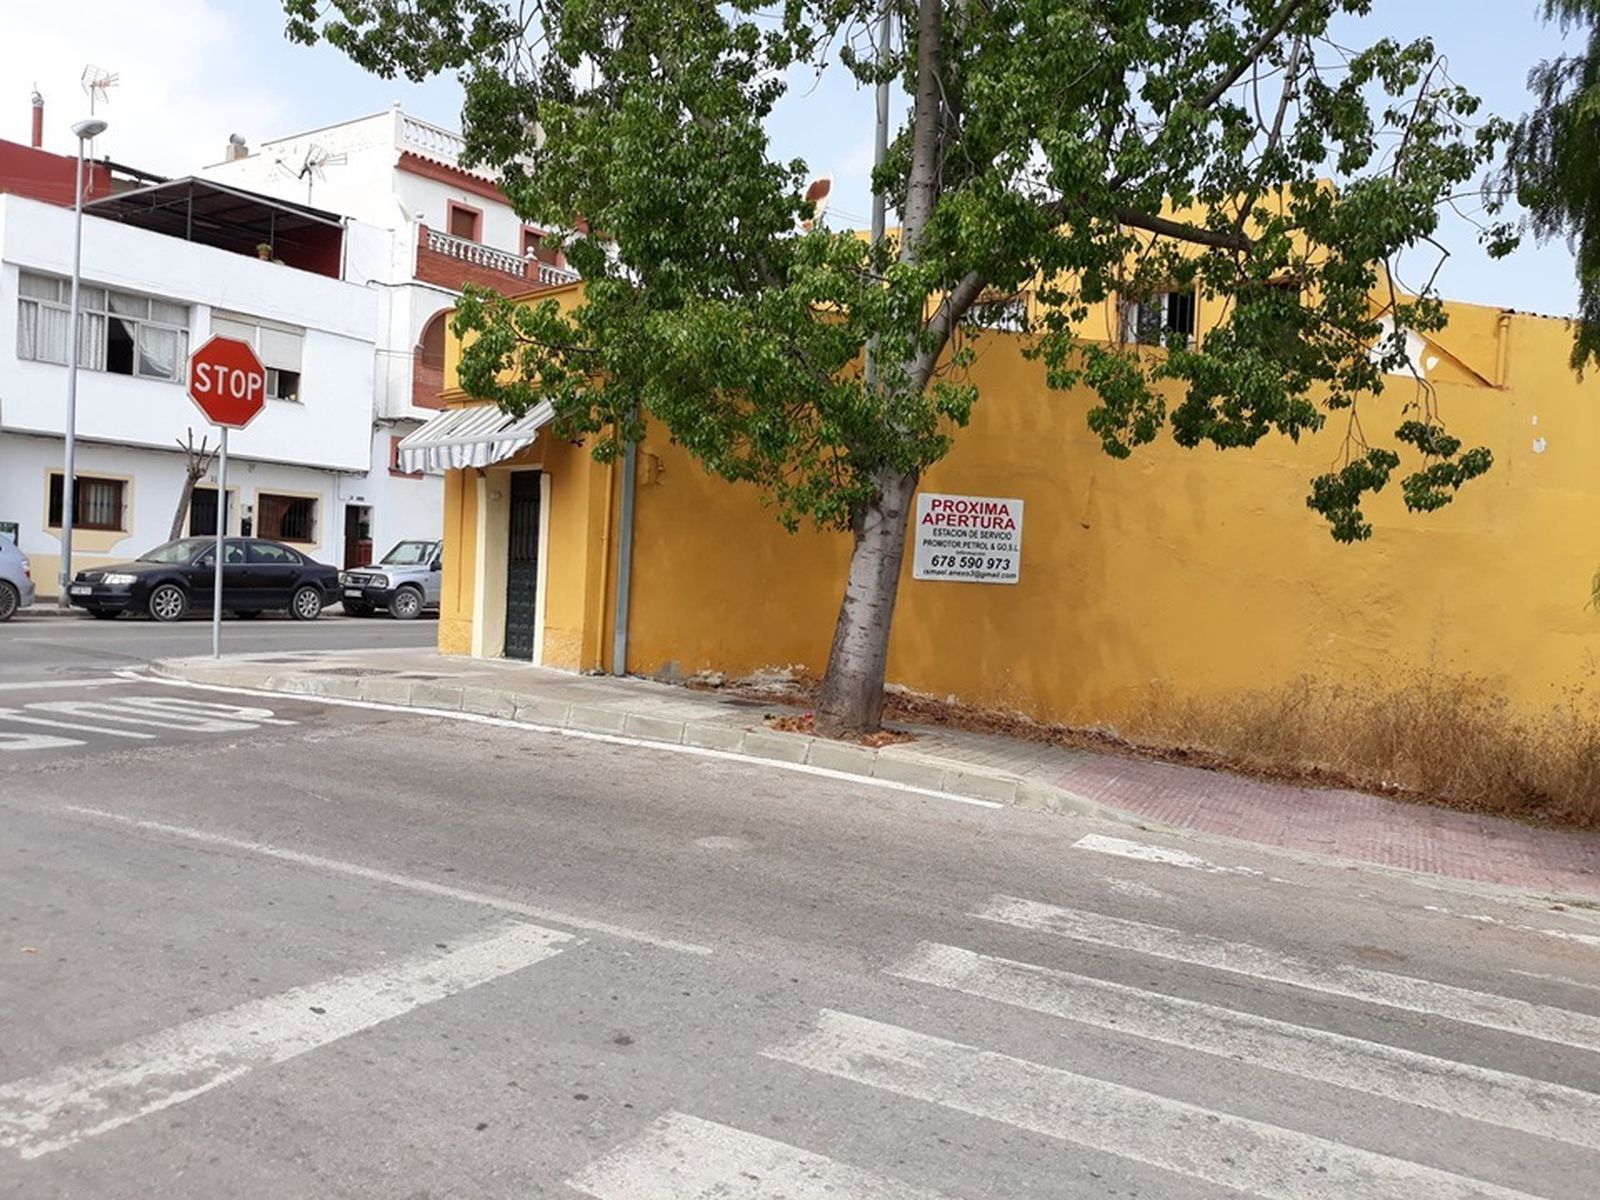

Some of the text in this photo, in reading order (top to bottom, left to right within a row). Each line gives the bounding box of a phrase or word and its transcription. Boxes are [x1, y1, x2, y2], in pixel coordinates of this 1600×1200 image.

[194, 362, 262, 401] STOP
[931, 499, 1009, 517] PROXIMA
[922, 512, 1016, 530] APERTURA
[933, 528, 1013, 540] ESTACION DE SERVICIO
[990, 543, 996, 551] &
[931, 554, 1011, 570] 678 590 973
